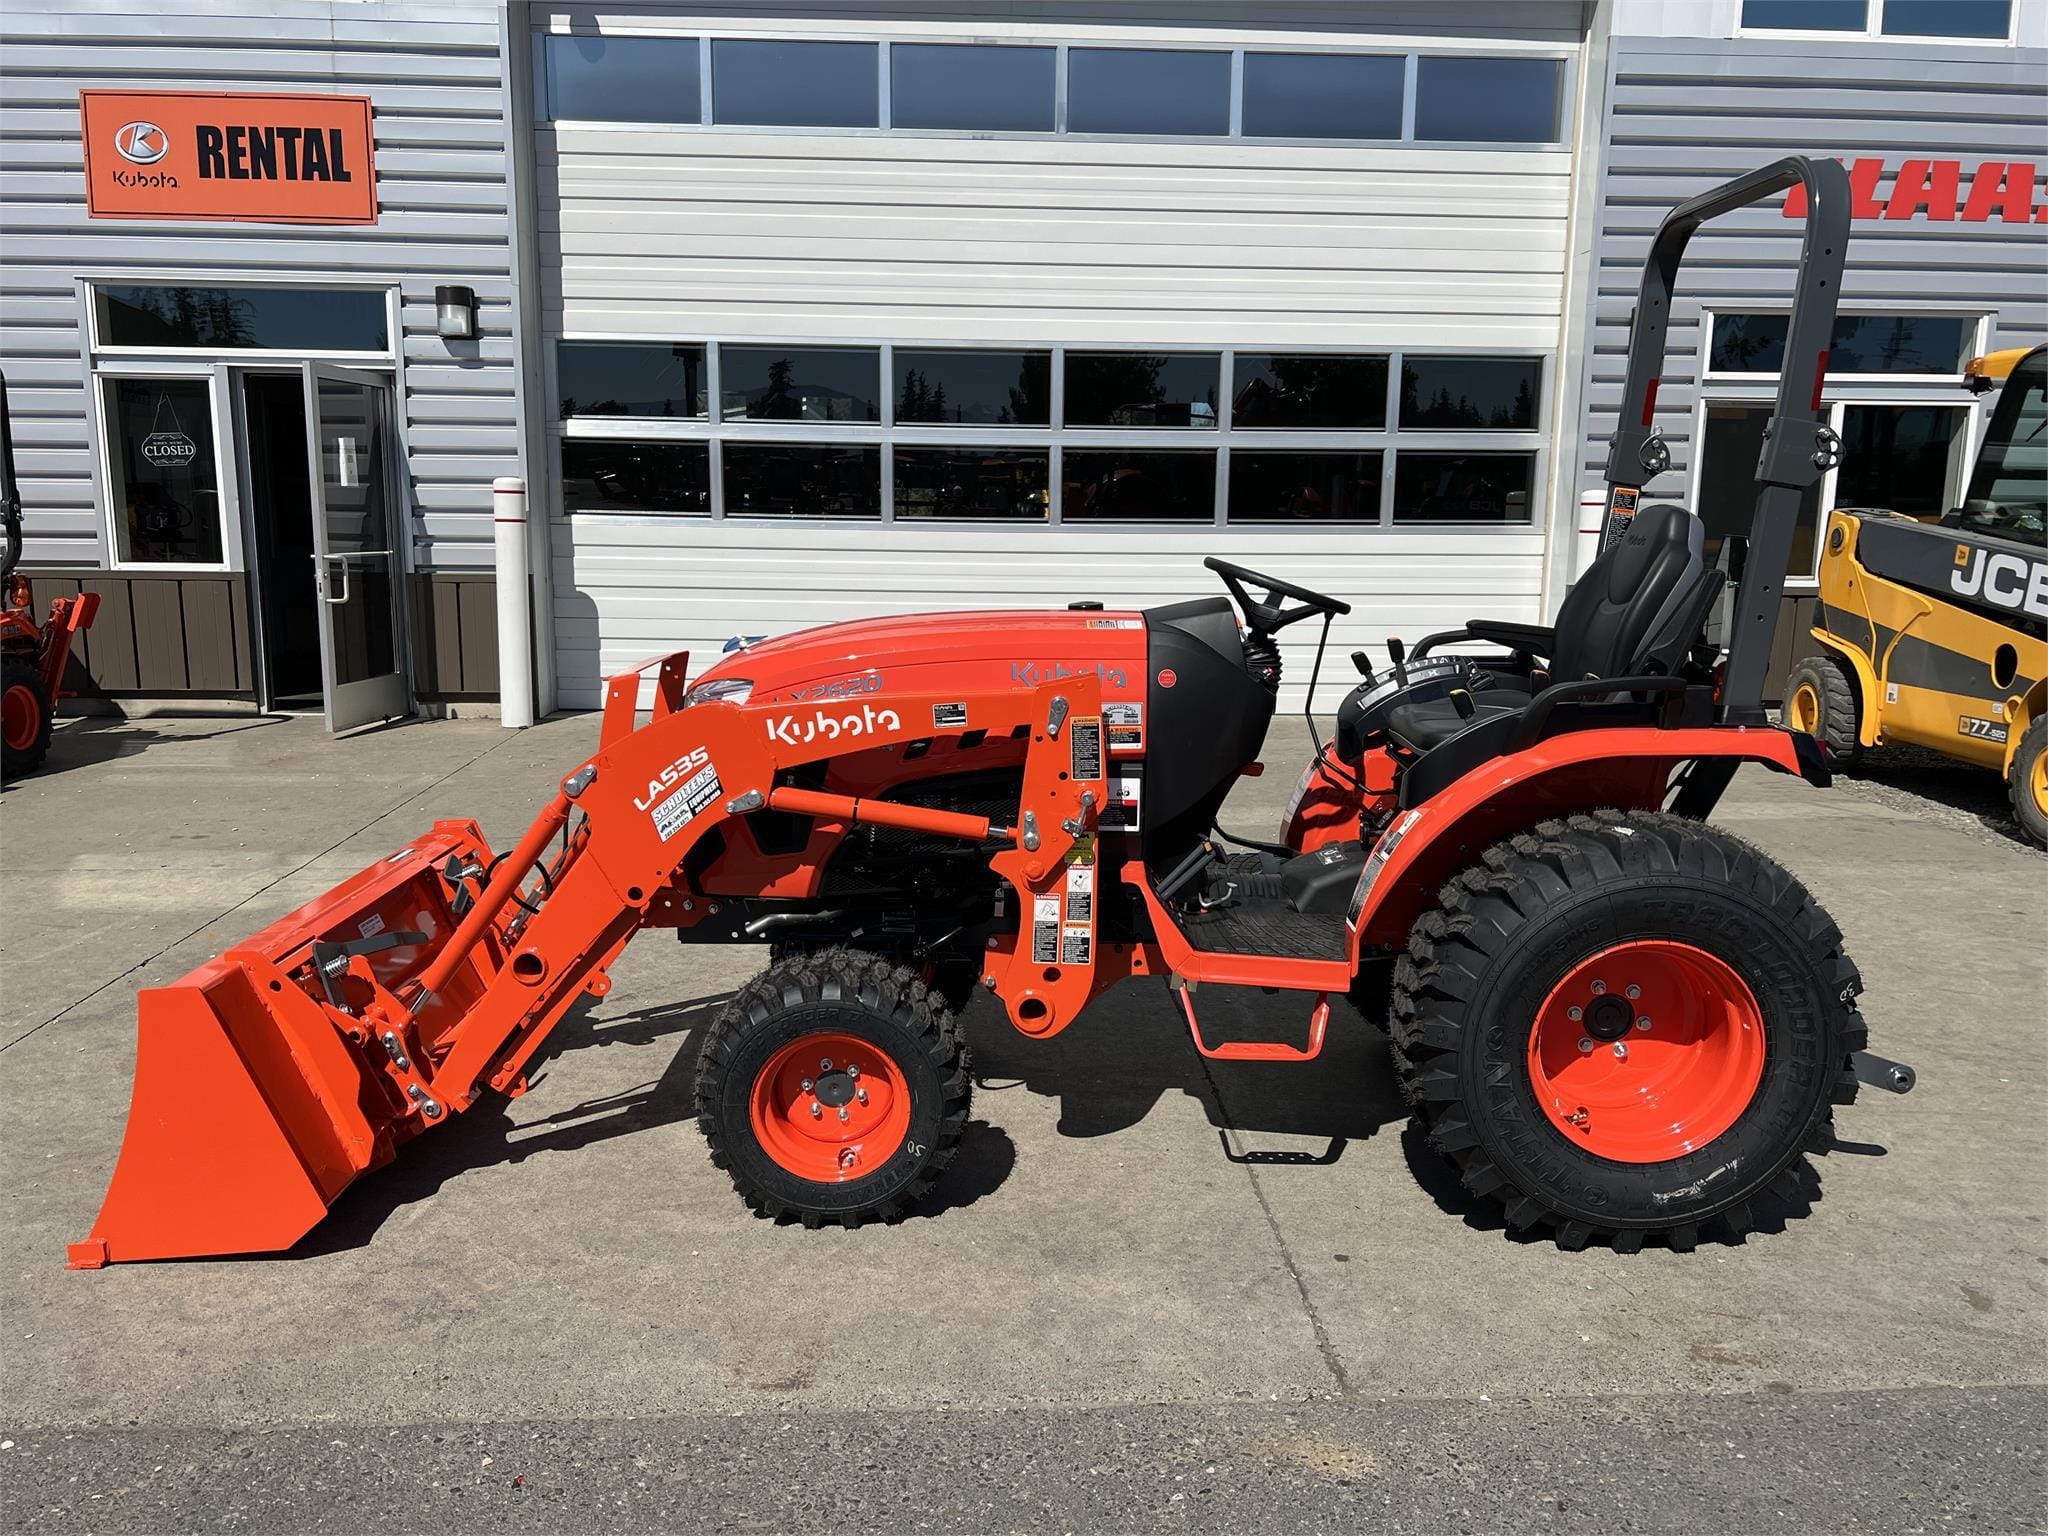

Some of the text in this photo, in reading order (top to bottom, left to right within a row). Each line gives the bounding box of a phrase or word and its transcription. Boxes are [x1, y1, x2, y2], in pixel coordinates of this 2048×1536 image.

[195, 125, 352, 183] RENTAL
[113, 171, 179, 189] Kubota
[1782, 158, 2048, 223] LAA
[144, 445, 195, 457] CLOSED
[1011, 662, 1127, 689] Kubta
[766, 704, 900, 745] Kubota
[633, 745, 709, 812] LA535
[654, 765, 716, 825] SCHOLTEN'S
[688, 778, 719, 809] EQUIPMENT
[1484, 1053, 1578, 1195] TITAN
